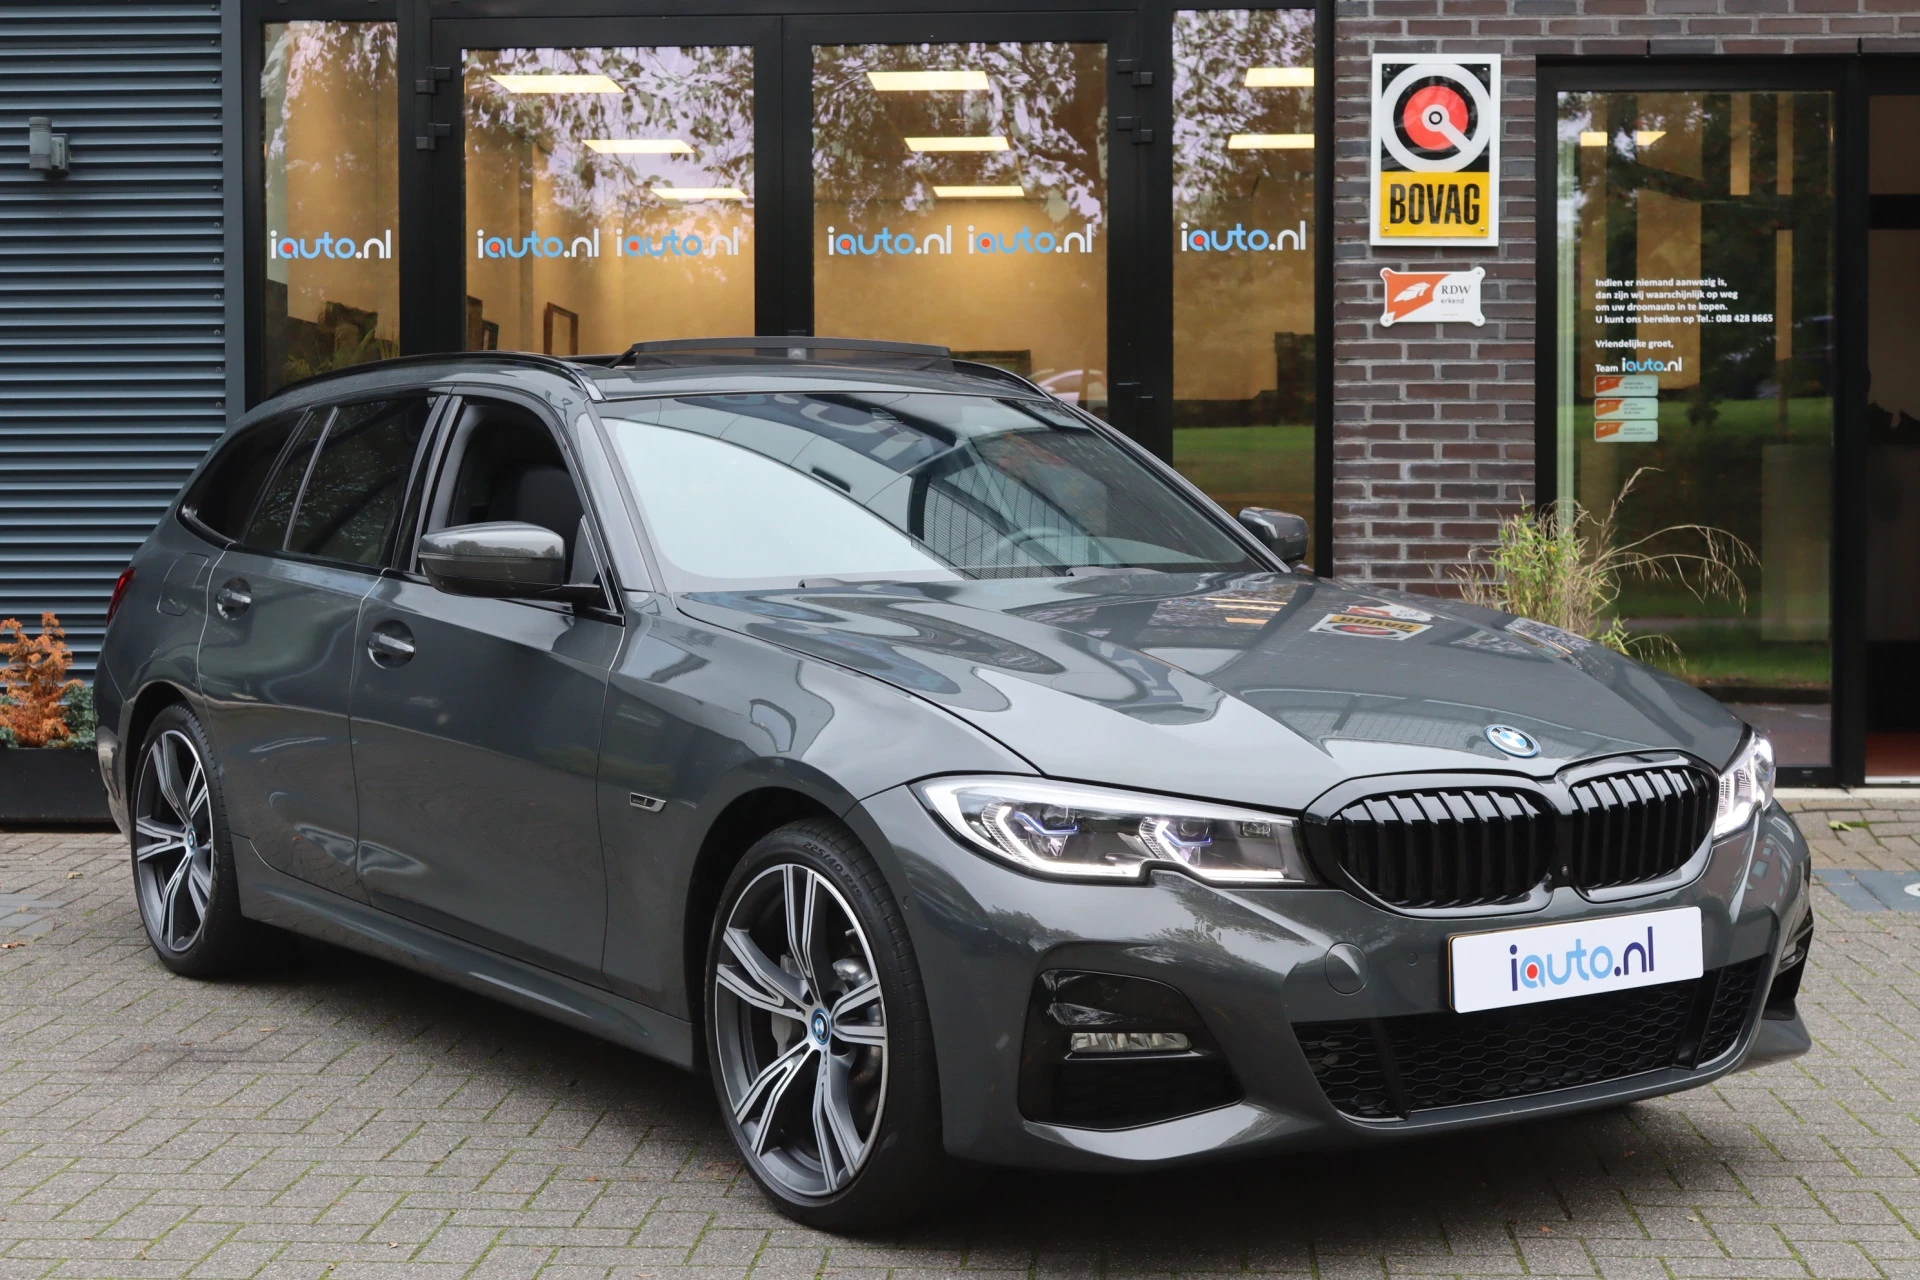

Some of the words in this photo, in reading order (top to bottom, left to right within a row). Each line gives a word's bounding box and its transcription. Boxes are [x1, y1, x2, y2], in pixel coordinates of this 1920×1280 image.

[1390, 183, 1480, 225] BOVAG
[270, 229, 391, 259] iauto.nl
[477, 228, 599, 258] iauto.nl
[616, 227, 739, 257] iauto.nl
[827, 225, 952, 255] iauto.nl
[967, 223, 1093, 254] iauto.nl
[1181, 220, 1306, 251] iauto.nl
[1441, 285, 1471, 295] RDW
[1595, 278, 1623, 287] Indien
[1624, 279, 1634, 287] er
[1636, 278, 1674, 287] niemand
[1675, 277, 1716, 288] aanwezig
[1717, 277, 1728, 287] is,
[1595, 290, 1612, 299] dan
[1613, 290, 1629, 300] zijn
[1631, 290, 1645, 300] wij
[1646, 290, 1705, 300] waarschijnlijk
[1706, 291, 1718, 300] op
[1719, 291, 1739, 300] weg
[1627, 302, 1676, 311] droomauto
[1677, 302, 1686, 310] in
[1698, 302, 1728, 312] kopen.
[1595, 315, 1603, 323] U
[1604, 315, 1625, 323] kunt
[1643, 314, 1681, 323] bereiken
[1682, 316, 1695, 325] op
[1696, 314, 1714, 323] Tel.:
[1715, 314, 1732, 323] 088
[1733, 314, 1750, 323] 428
[1751, 313, 1774, 323] 8665
[1594, 339, 1647, 349] Vriendelijke
[1648, 339, 1674, 349] groet,
[1594, 363, 1619, 373] Team
[1621, 356, 1682, 372] iauto.nl
[1509, 926, 1655, 992] iauto.nl
